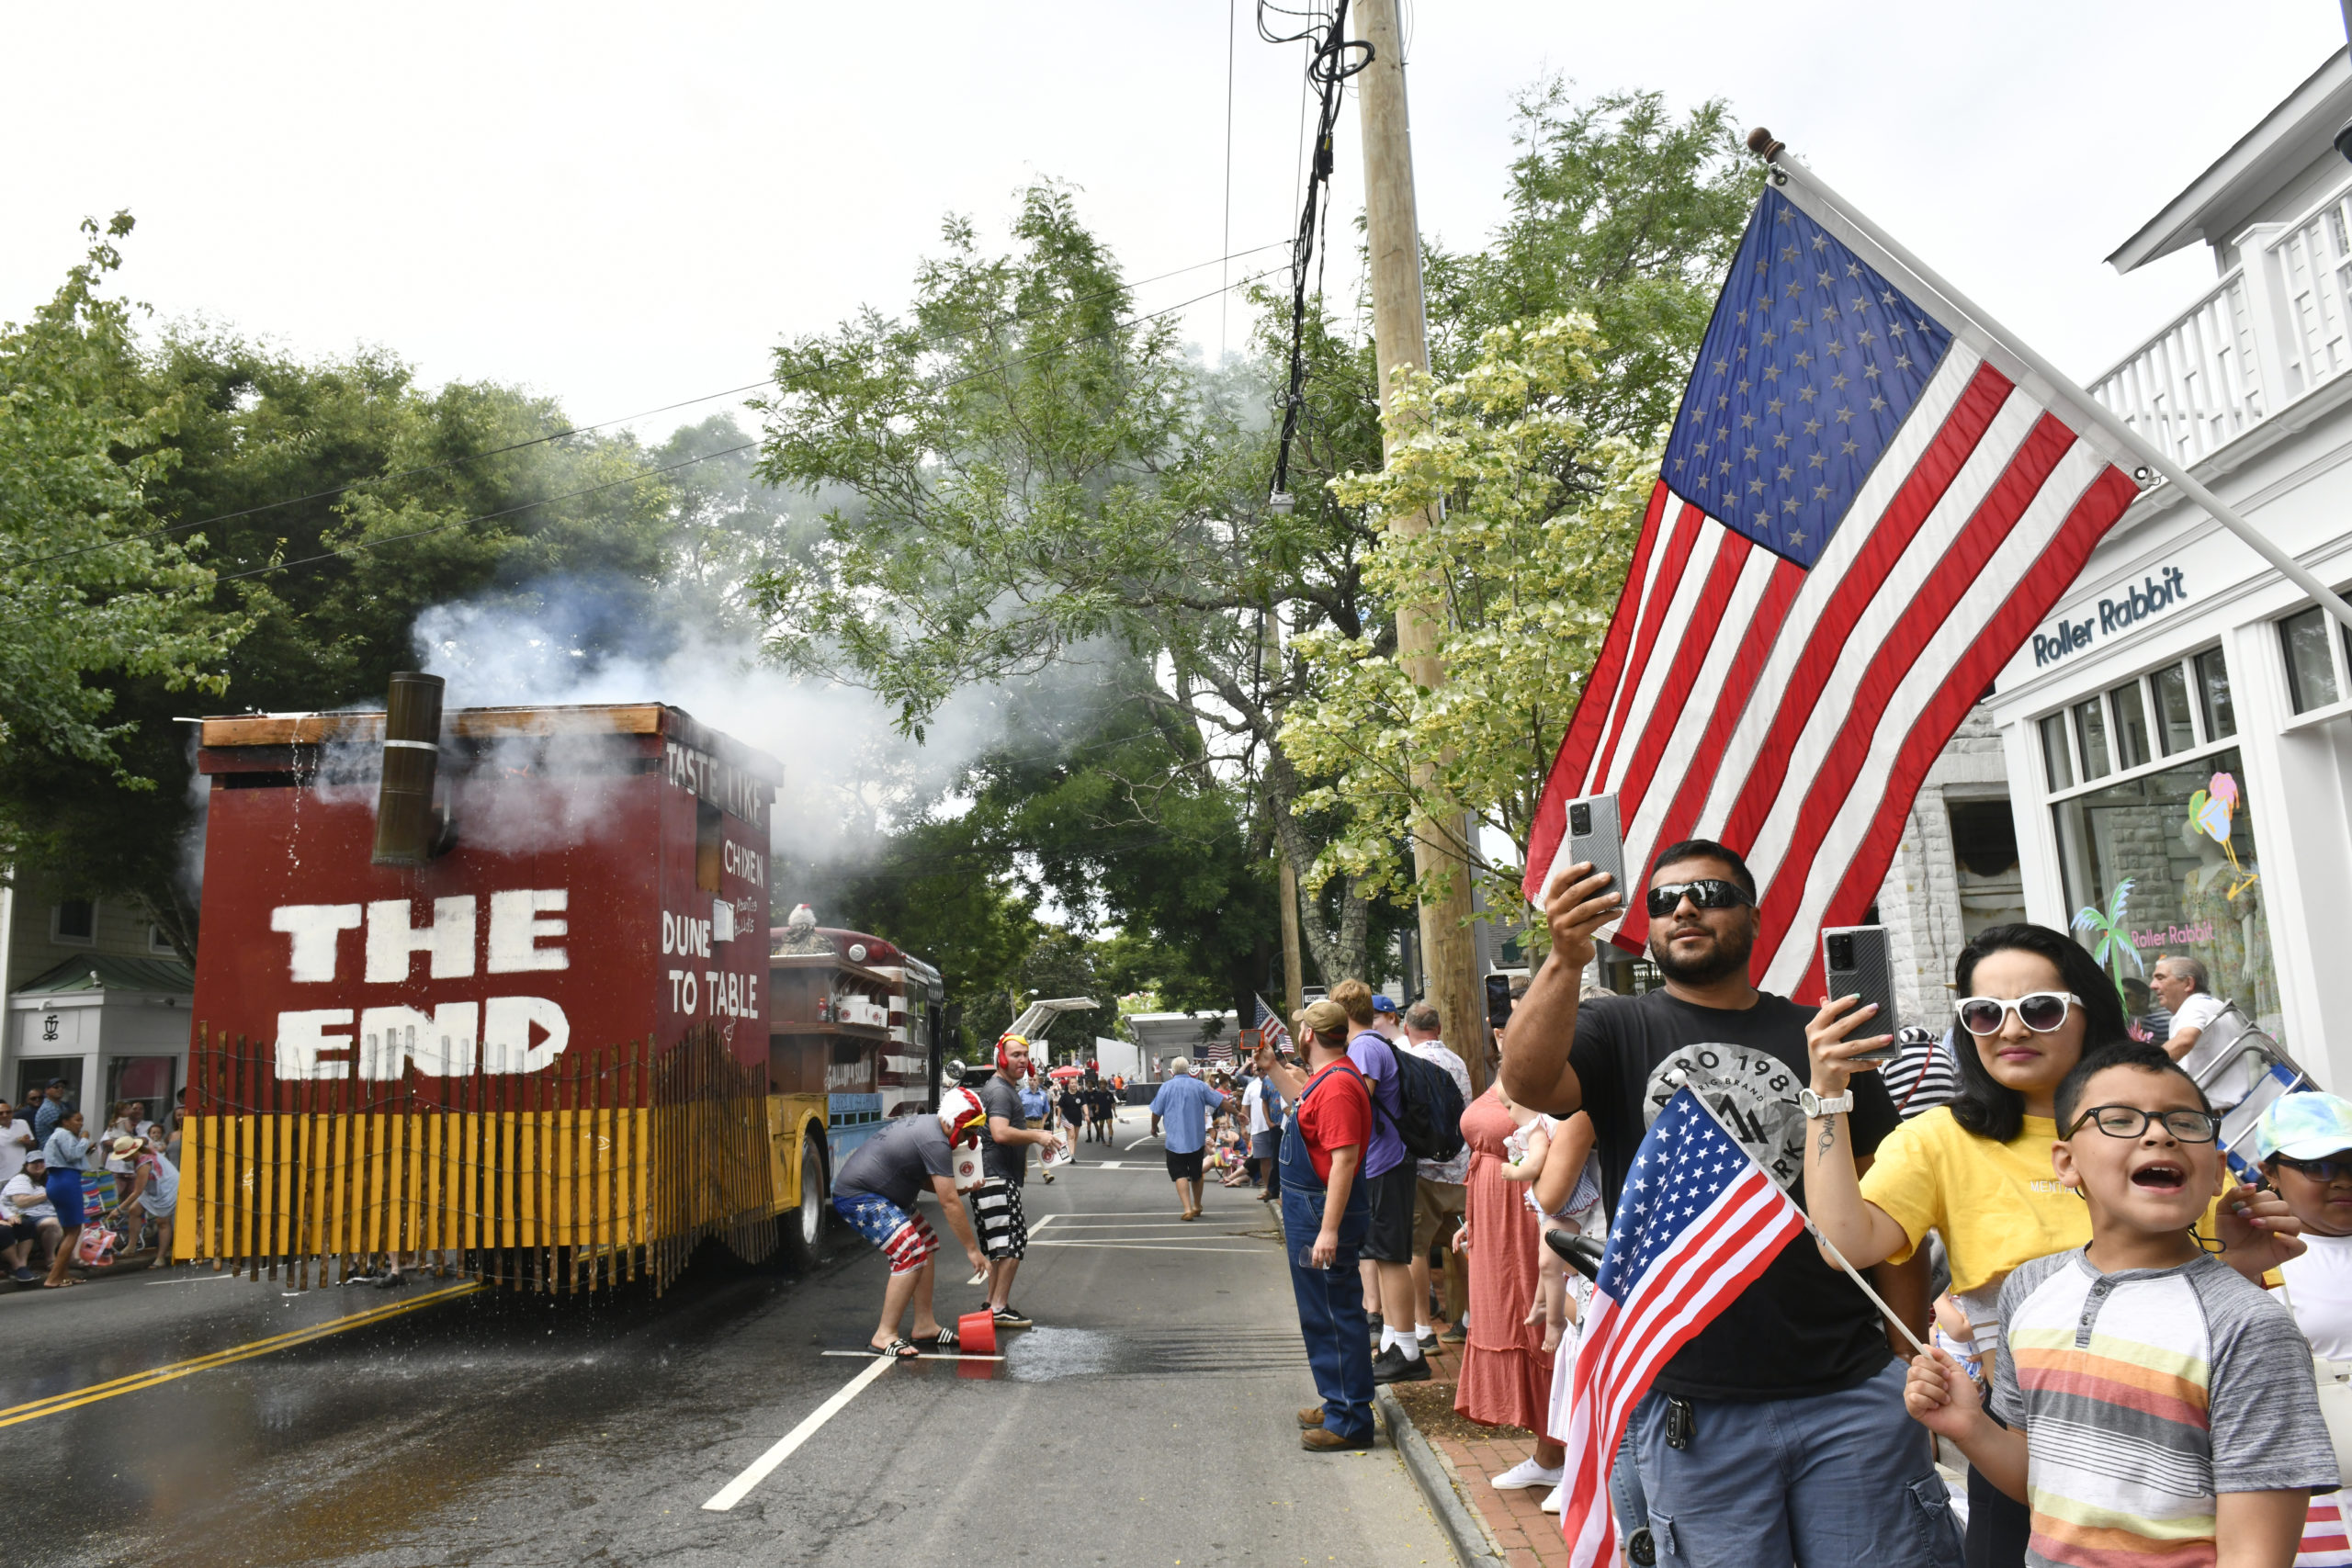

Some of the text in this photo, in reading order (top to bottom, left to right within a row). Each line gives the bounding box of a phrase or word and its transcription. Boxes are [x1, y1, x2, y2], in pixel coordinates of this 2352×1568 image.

[2031, 566, 2188, 668] Roller Rabbit
[666, 741, 763, 831] TASTE LIKE
[270, 888, 571, 984] THE
[662, 909, 711, 959] DUNE
[2131, 921, 2215, 949] Roller Rabbit
[669, 969, 759, 1020] TO TABLE
[274, 996, 571, 1082] END
[1652, 1050, 1720, 1108] AERO
